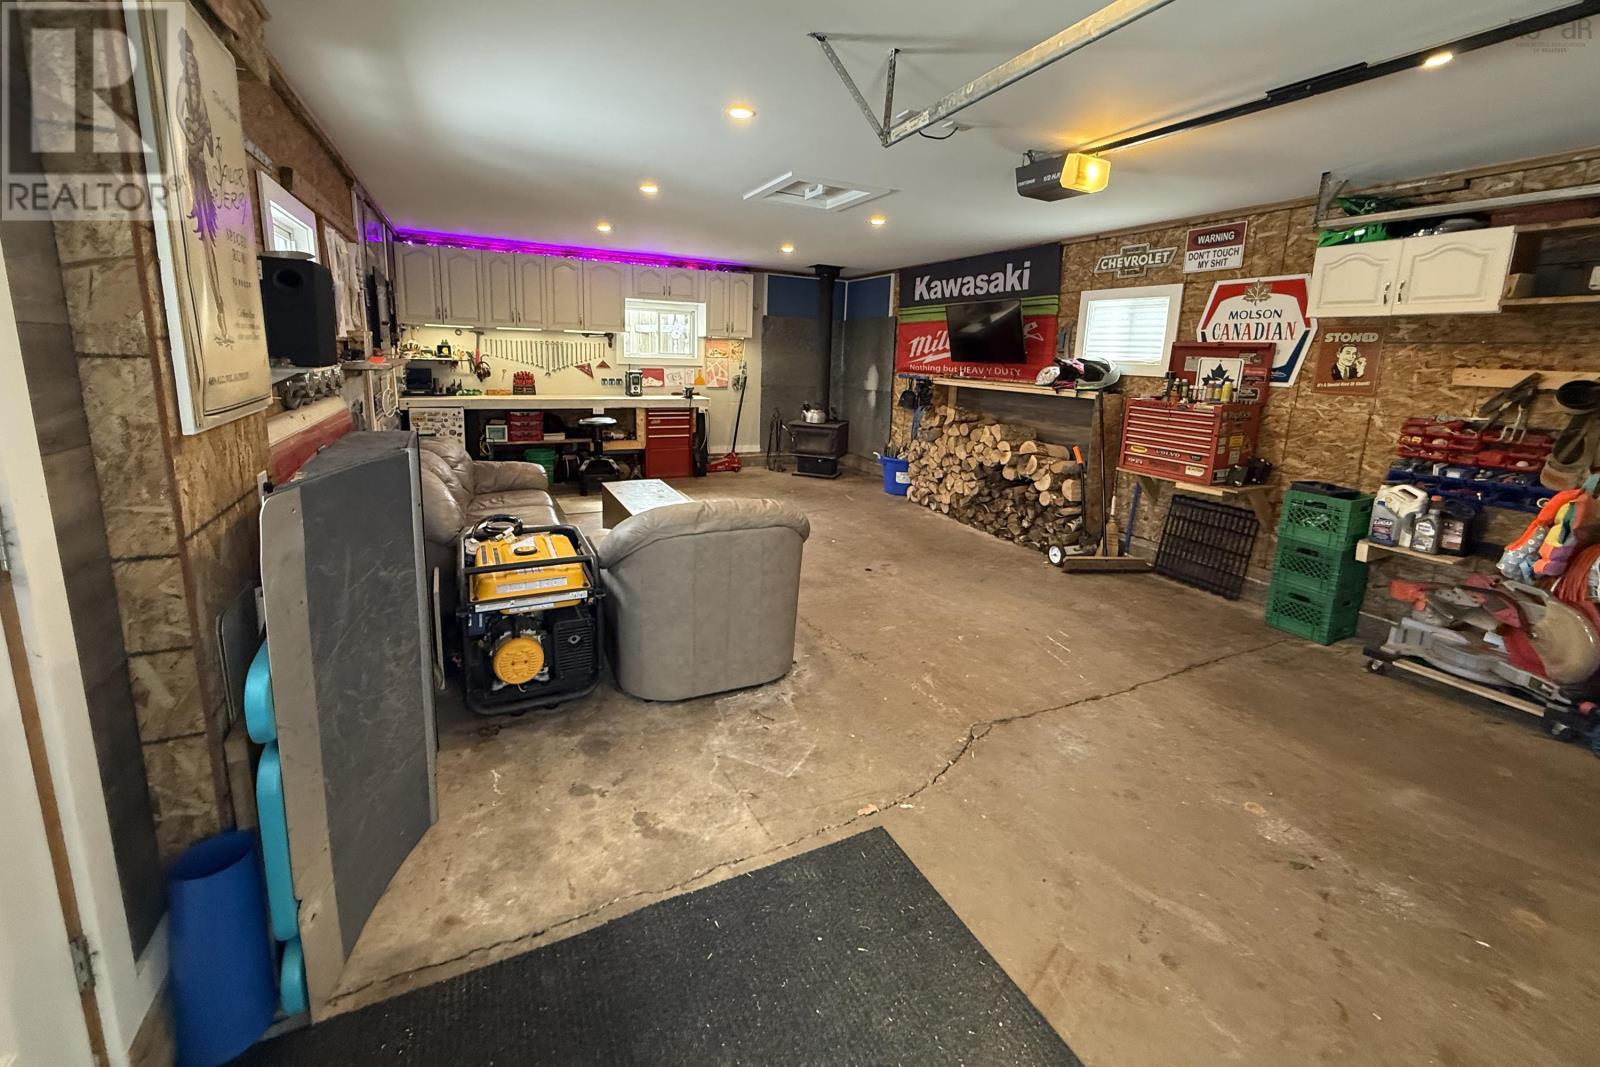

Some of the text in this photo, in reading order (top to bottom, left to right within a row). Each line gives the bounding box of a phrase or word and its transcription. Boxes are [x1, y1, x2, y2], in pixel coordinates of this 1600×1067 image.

[1197, 230, 1235, 245] WARNING
[1100, 251, 1170, 270] CHEVROLET
[1188, 247, 1240, 261] DON'T TOUCH
[1197, 257, 1228, 269] MY SHIT
[914, 261, 1031, 300] Kawasaki
[1228, 309, 1283, 320] MOLSON
[1212, 321, 1297, 341] CANADIAN
[1324, 332, 1379, 343] STONED
[909, 364, 1021, 377] Nothing but HEAVY DUTY
